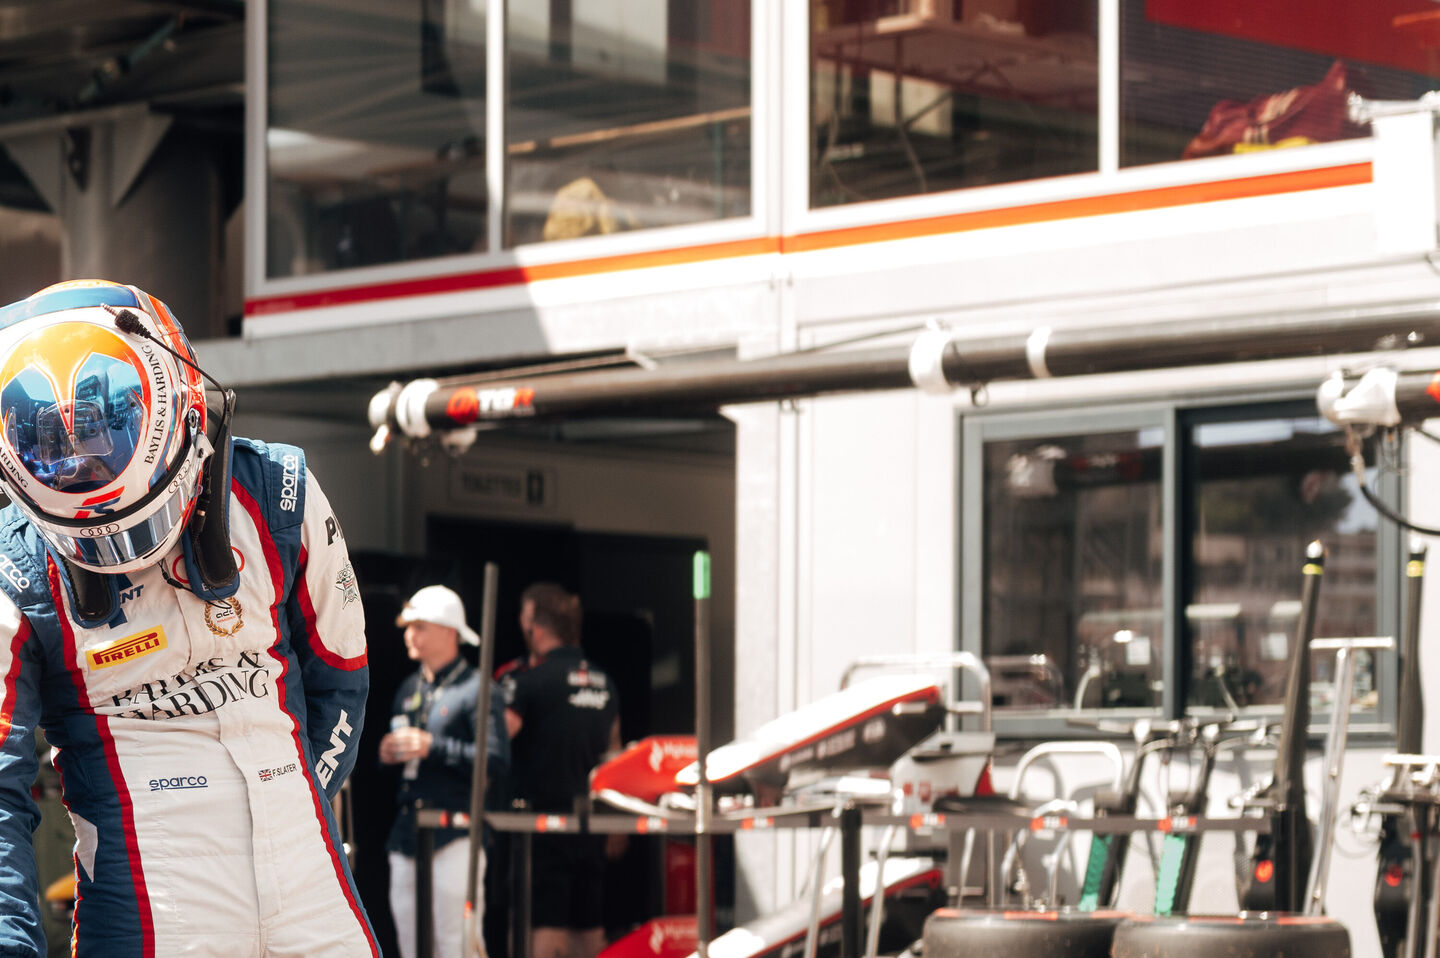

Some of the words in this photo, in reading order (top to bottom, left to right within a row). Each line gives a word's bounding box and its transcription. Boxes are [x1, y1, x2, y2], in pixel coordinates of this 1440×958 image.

[141, 344, 167, 404] HARDING
[157, 406, 167, 417] &
[144, 419, 165, 465] BAYLIS
[279, 453, 299, 513] sparco
[92, 631, 161, 666] PIRELLI
[148, 775, 209, 792] sparco
